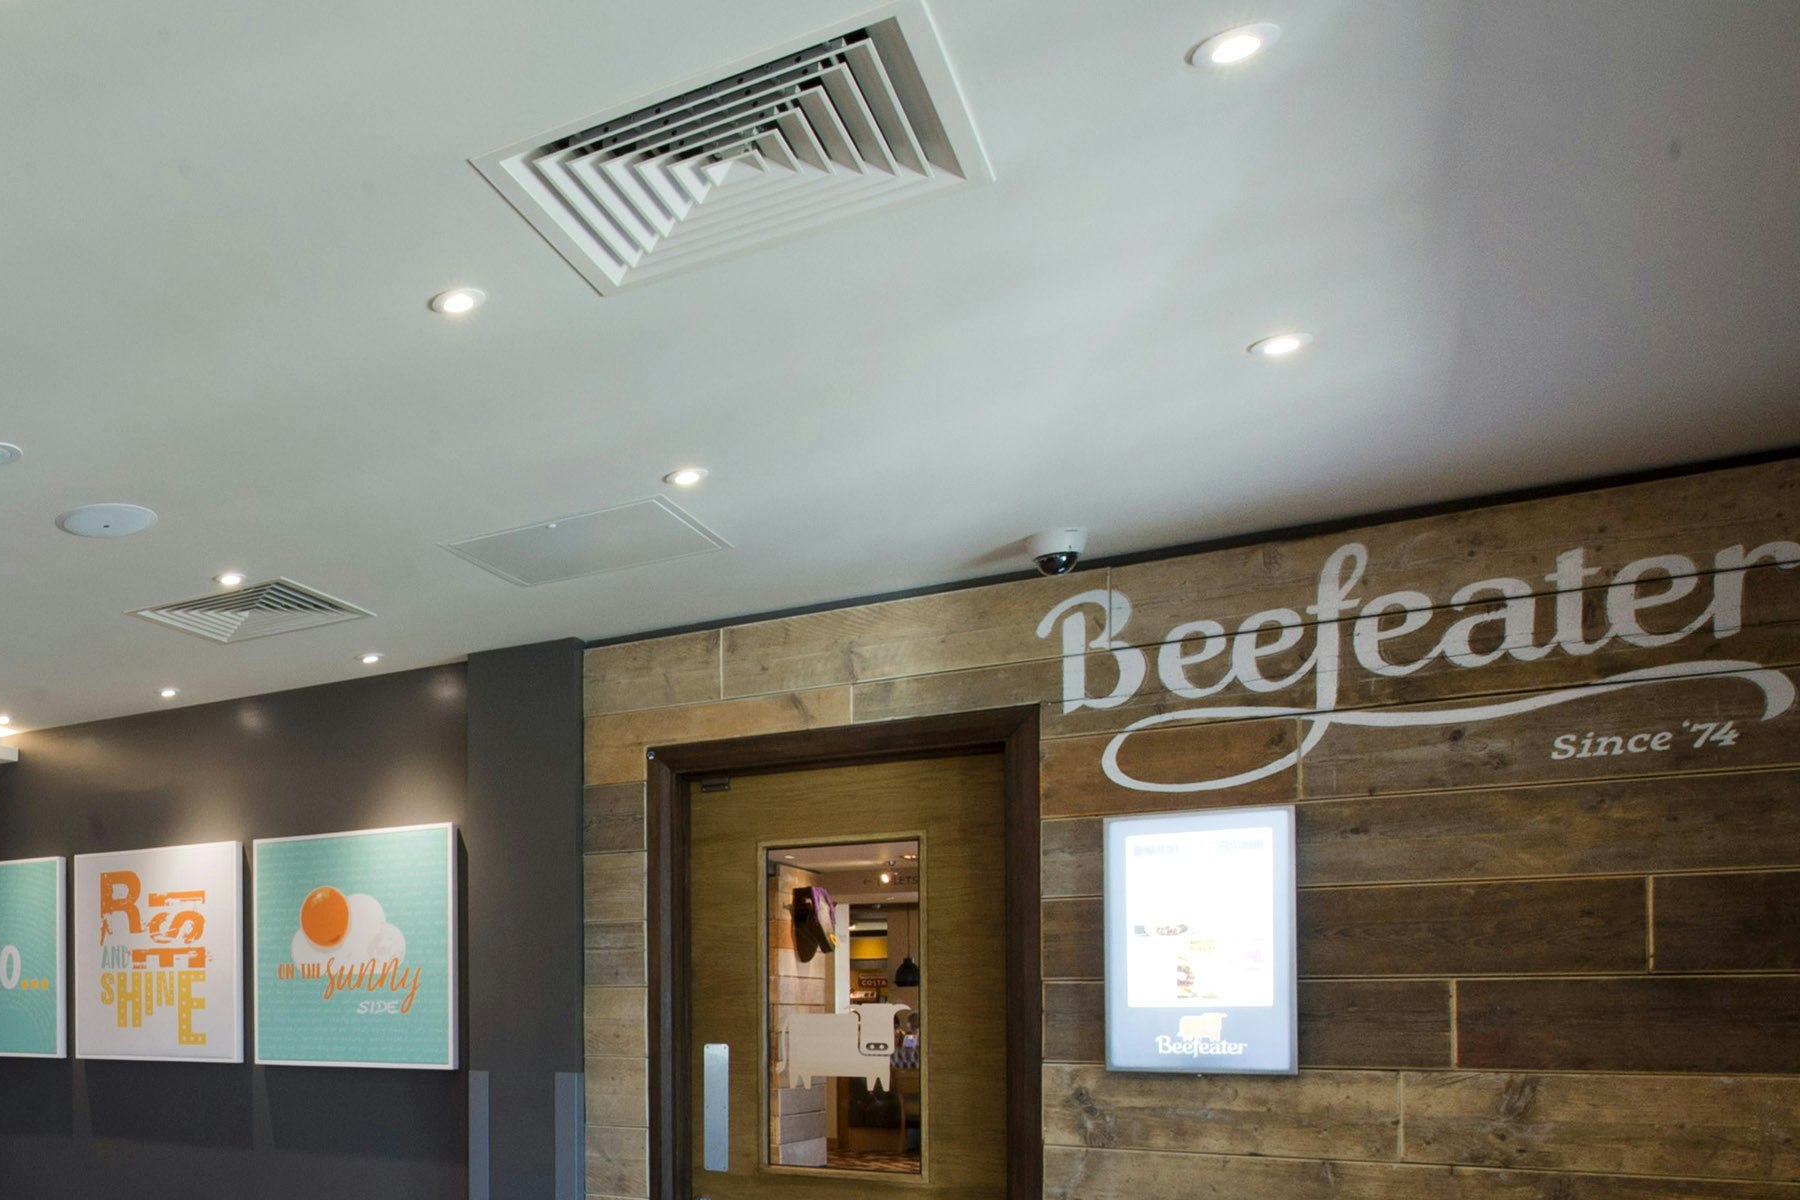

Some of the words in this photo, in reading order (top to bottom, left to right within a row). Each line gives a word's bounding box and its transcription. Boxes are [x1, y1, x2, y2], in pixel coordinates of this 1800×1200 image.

[1036, 543, 1800, 788] Beefeater
[1551, 731, 1673, 760] Since
[101, 945, 130, 969] AND
[278, 963, 295, 980] ON
[861, 979, 887, 987] COSTA
[101, 970, 207, 1045] SHINE
[357, 1000, 400, 1015] SIDE
[1155, 1035, 1248, 1059] Beefeater
